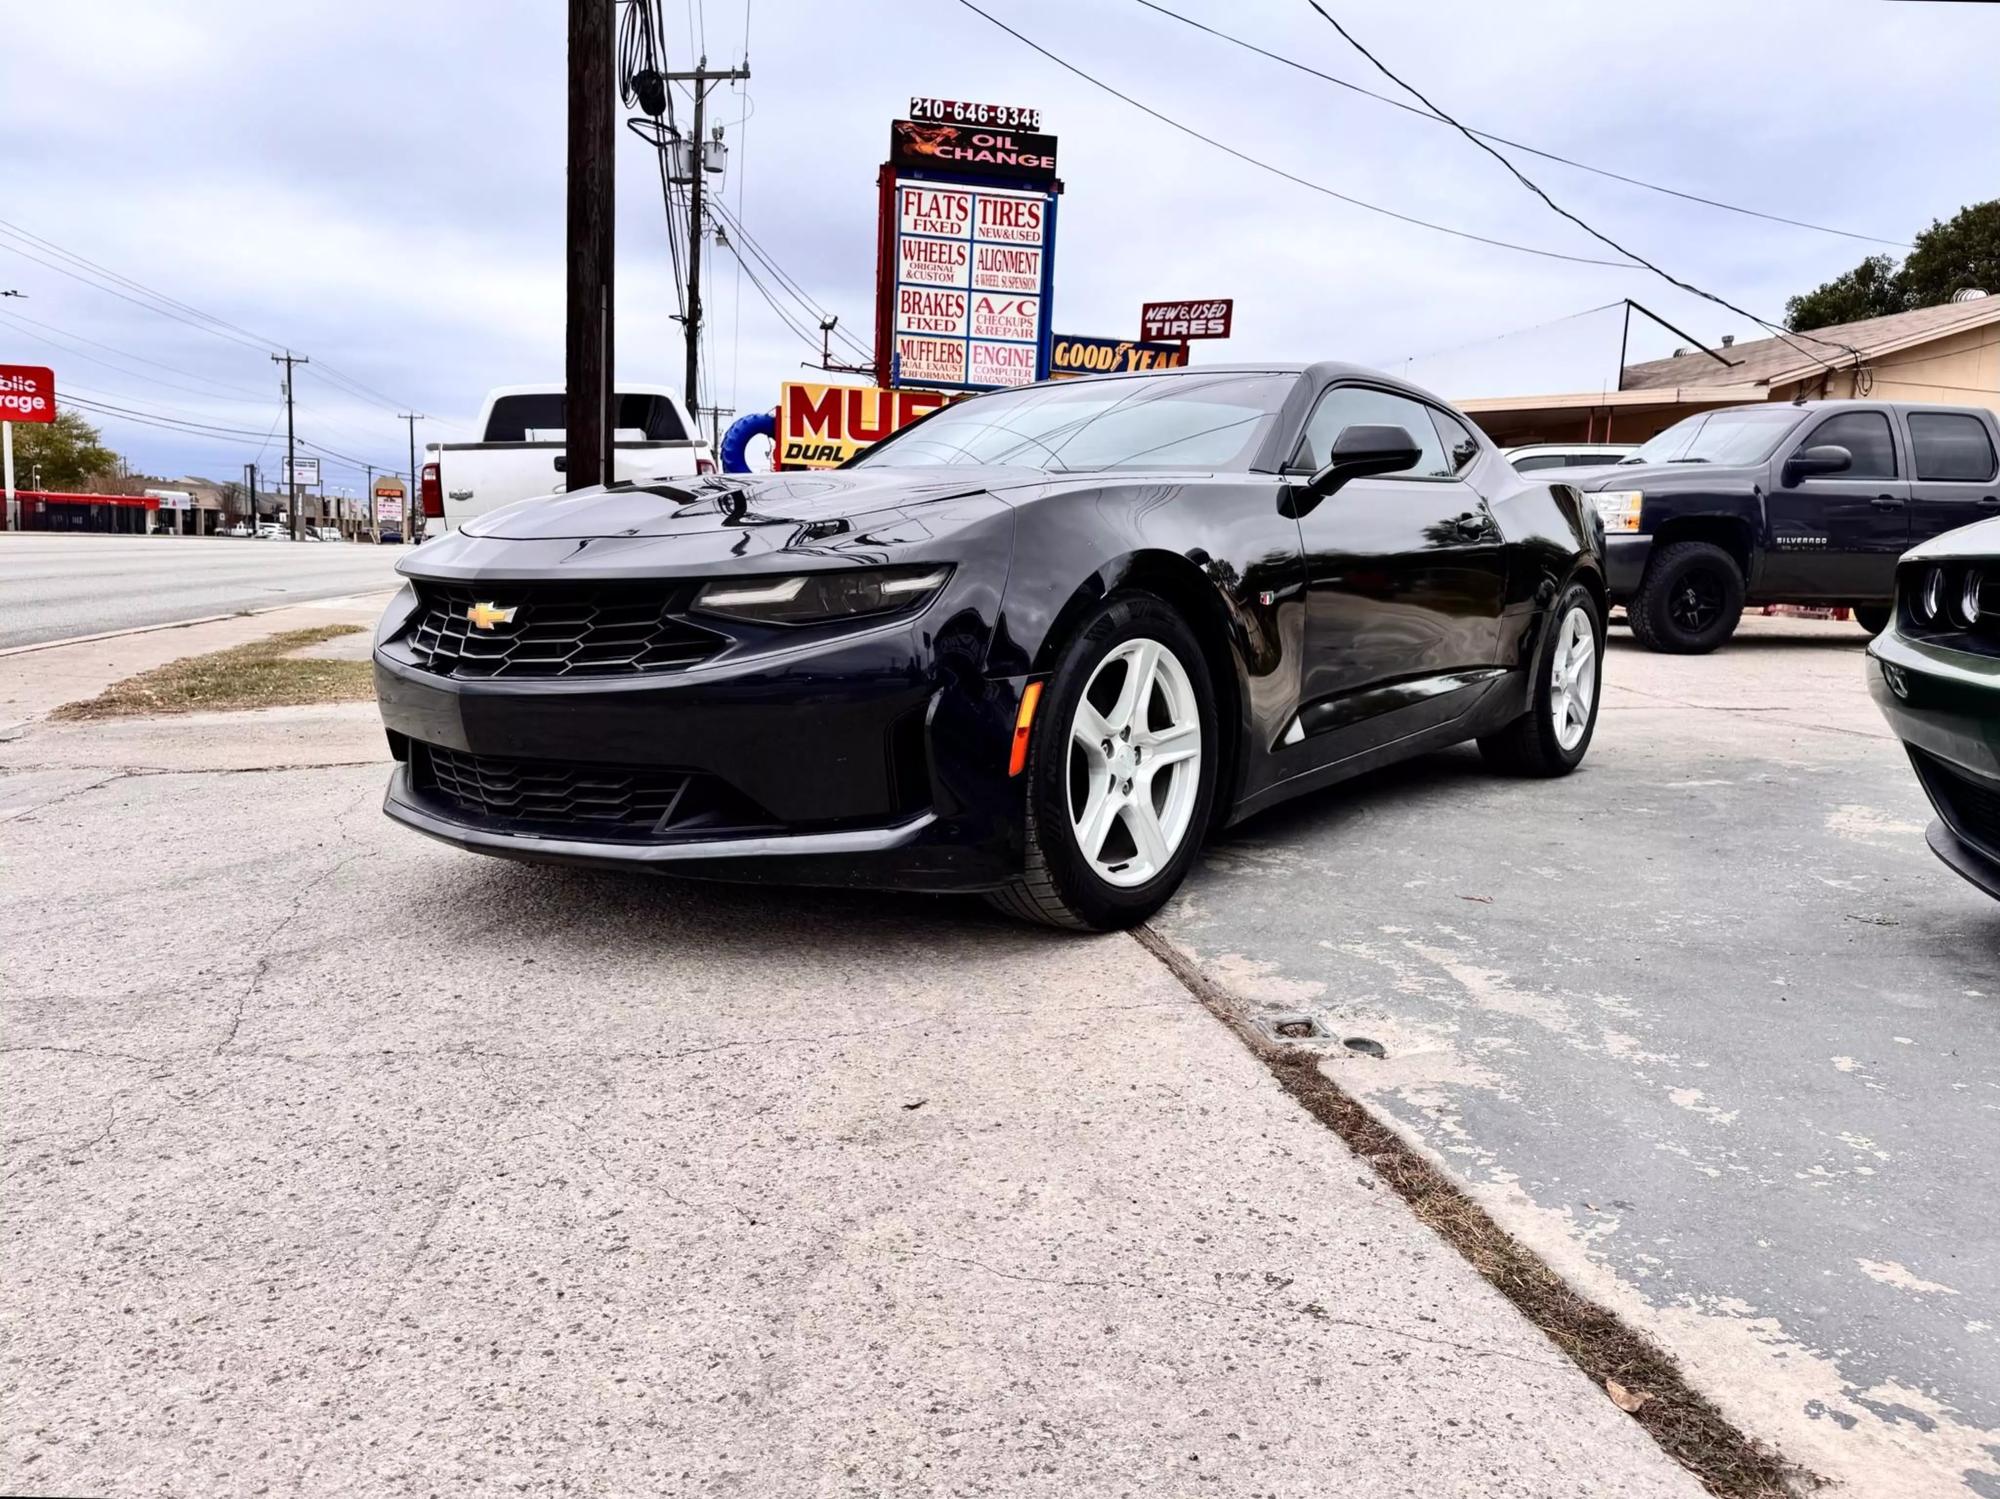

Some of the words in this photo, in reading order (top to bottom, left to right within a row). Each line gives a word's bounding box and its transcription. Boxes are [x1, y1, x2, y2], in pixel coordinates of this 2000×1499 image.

[911, 97, 1041, 127] 210-646-9348
[972, 134, 1019, 150] OIL
[935, 146, 1055, 168] CHANGE
[903, 191, 969, 221] FLATS
[978, 198, 1040, 229] TIRES
[913, 218, 962, 235] FIXED
[902, 239, 966, 266] WHEELS
[976, 248, 1040, 275] ALIGNMENT
[909, 262, 954, 273] ORIGINAL
[975, 273, 979, 286] 4
[980, 273, 1000, 288] WHEEL
[1001, 275, 1037, 290] SUSPENSION
[900, 290, 965, 319] BRAKES
[974, 297, 1037, 317] A/C
[906, 316, 957, 333] FIXED
[976, 314, 1034, 328] CHECKUPS
[1146, 319, 1225, 336] TIRES
[899, 339, 963, 365] MUFFLERS
[973, 345, 1035, 369] ENGINE
[974, 365, 1032, 378] COMPUTER
[785, 443, 844, 462] DUAL
